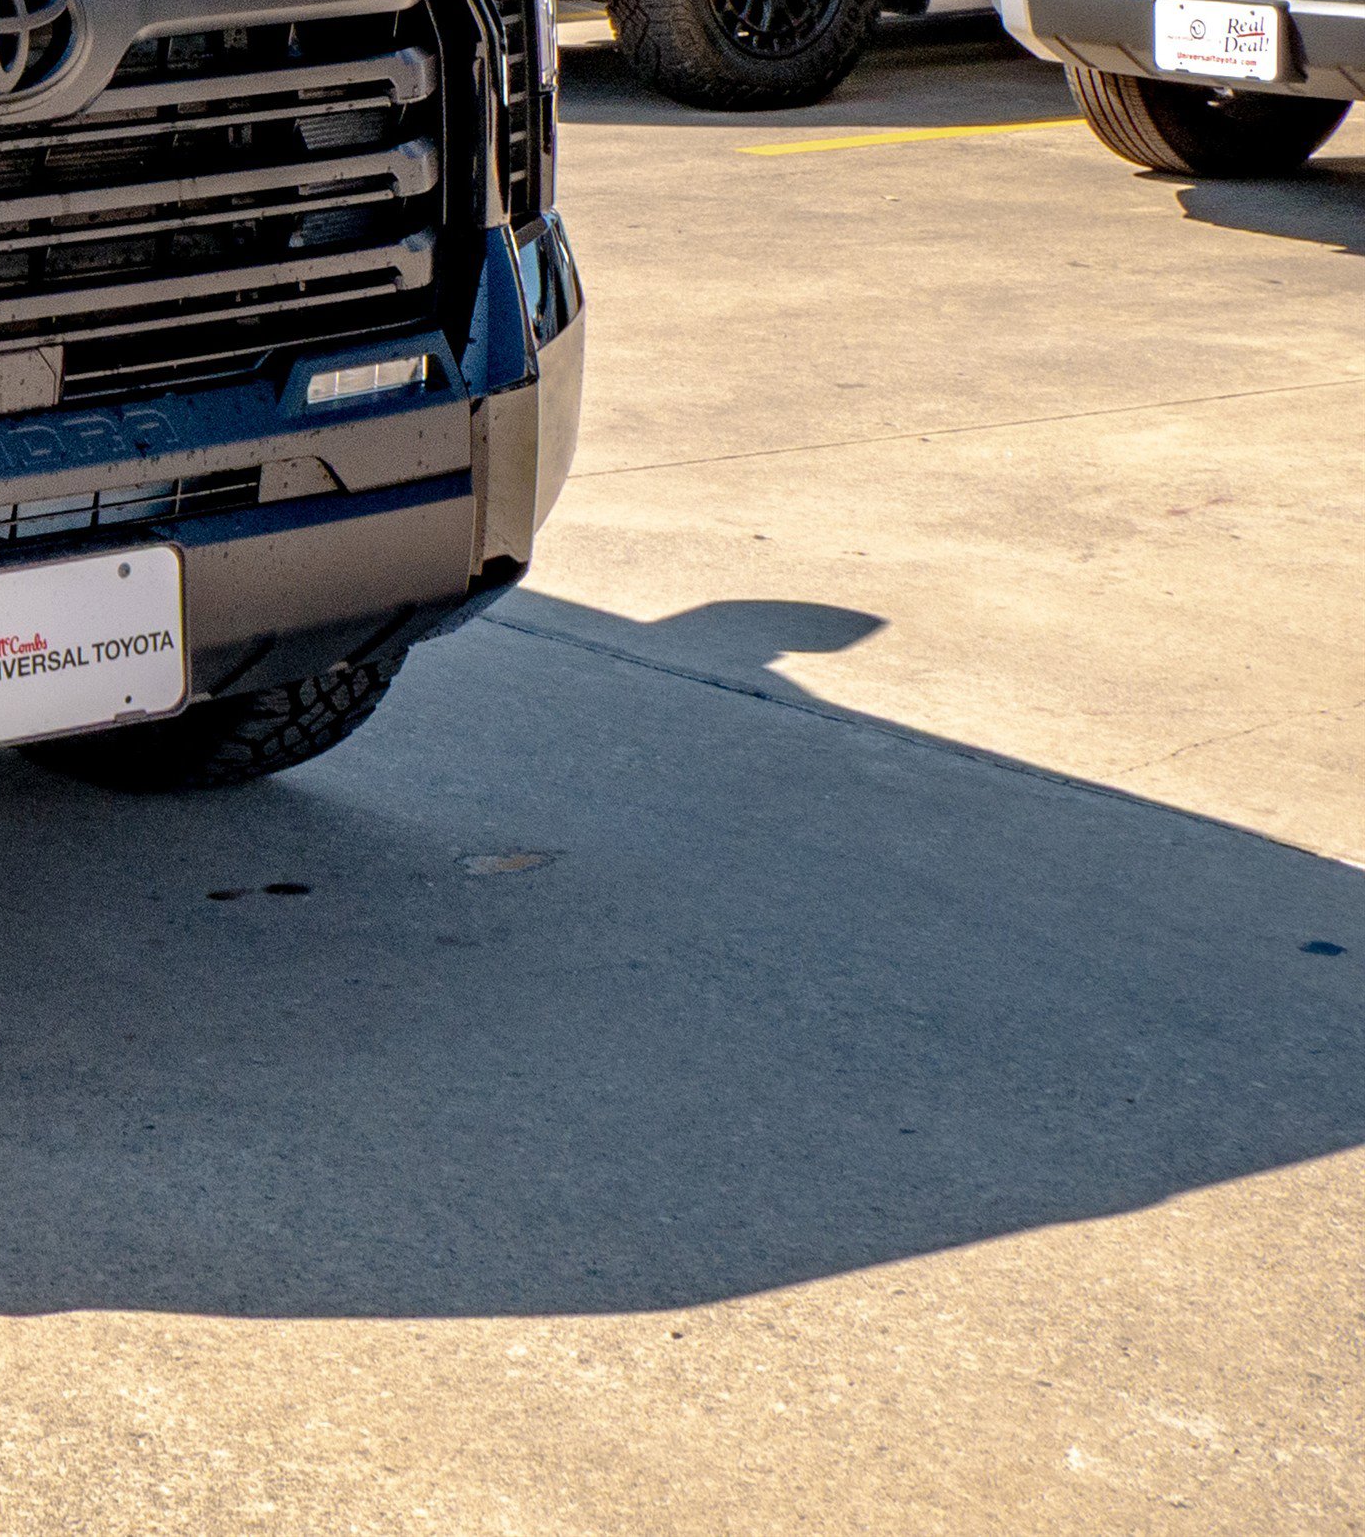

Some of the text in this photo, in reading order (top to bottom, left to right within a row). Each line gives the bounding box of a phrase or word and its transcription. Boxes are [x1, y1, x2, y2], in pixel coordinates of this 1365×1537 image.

[1227, 16, 1265, 35] Real
[1224, 36, 1270, 53] Deal!
[92, 630, 175, 663] TOYOTA
